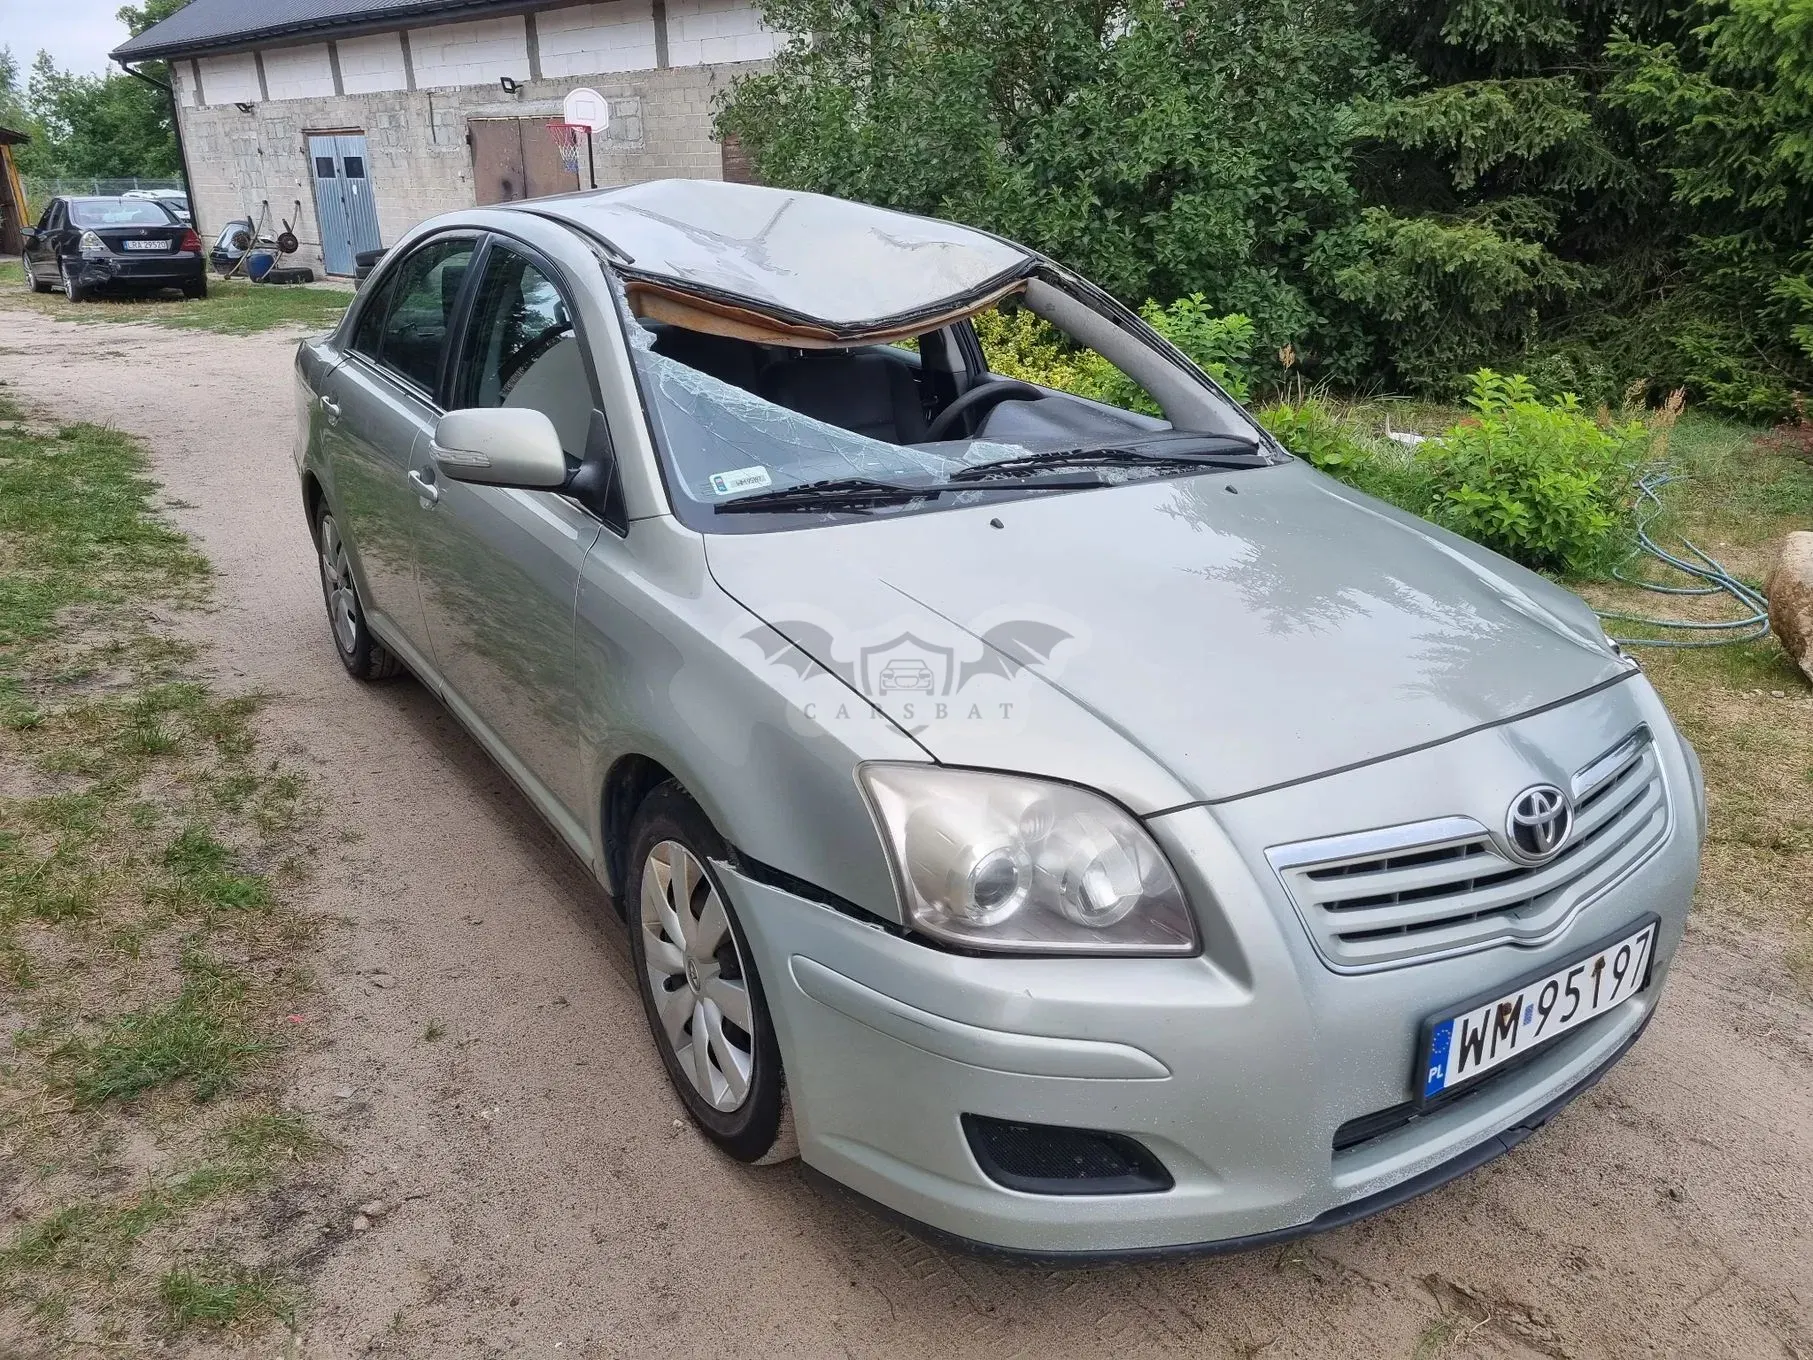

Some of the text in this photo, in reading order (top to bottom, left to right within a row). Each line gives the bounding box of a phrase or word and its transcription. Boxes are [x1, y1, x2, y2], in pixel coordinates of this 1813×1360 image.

[1458, 931, 1650, 1073] WM 95197
[1428, 1064, 1443, 1083] PL
